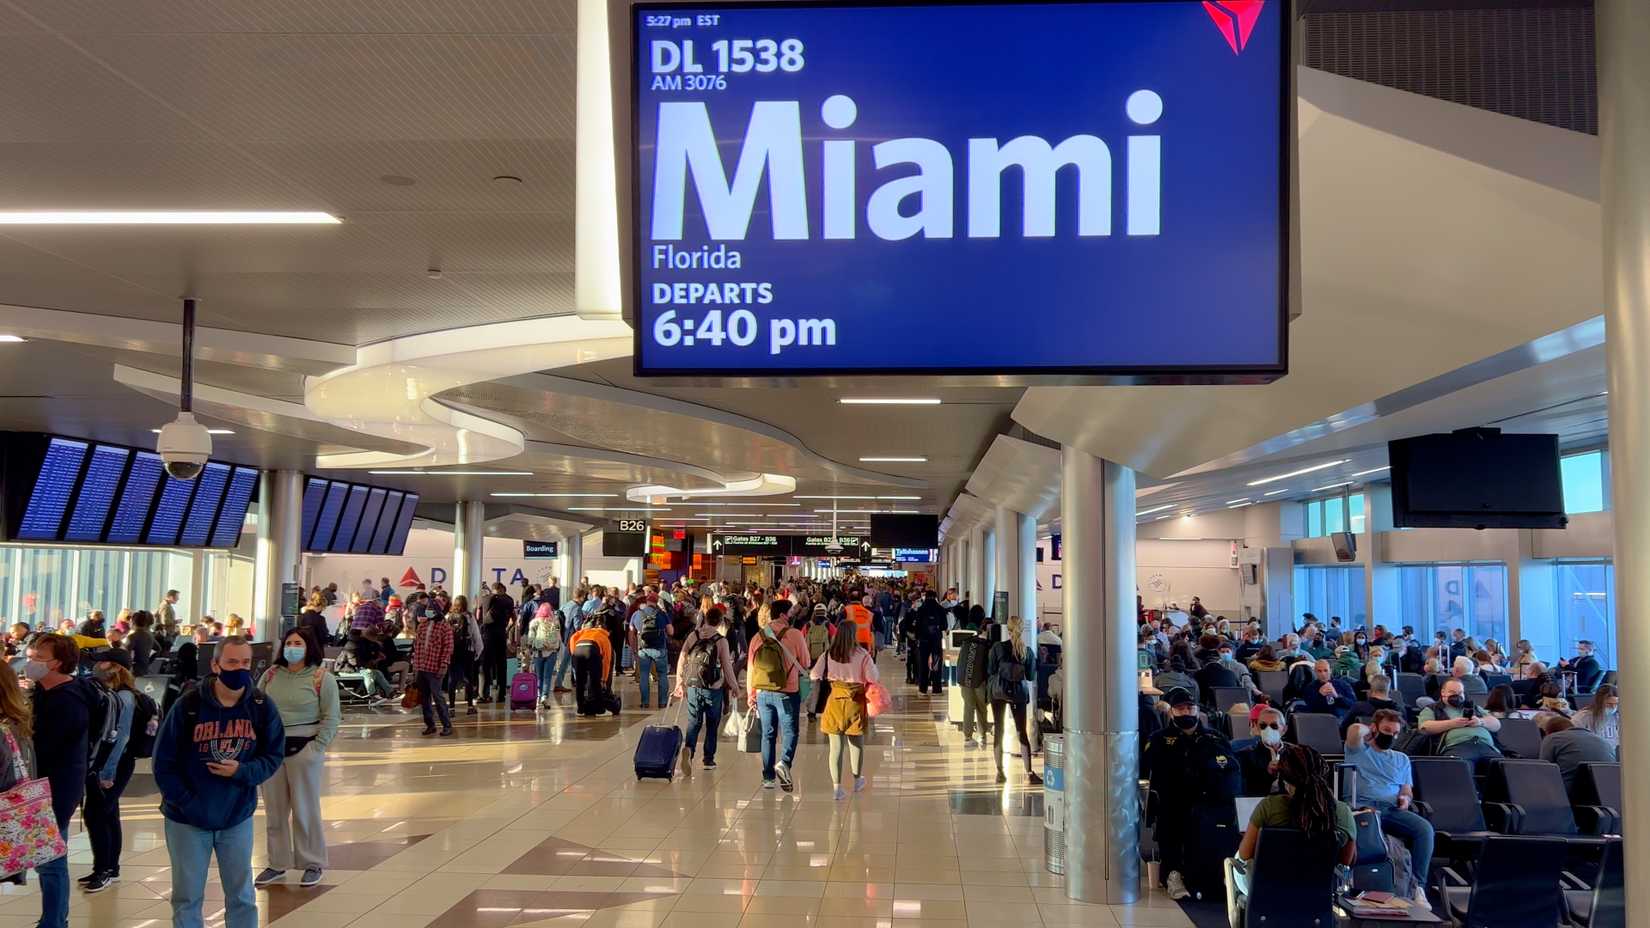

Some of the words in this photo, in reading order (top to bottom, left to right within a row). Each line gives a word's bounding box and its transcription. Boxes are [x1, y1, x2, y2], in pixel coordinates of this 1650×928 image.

[647, 16, 671, 27] 5:27
[672, 17, 691, 28] pm
[697, 15, 720, 26] EST
[651, 40, 703, 72] DL
[712, 39, 805, 72] 1538
[651, 76, 682, 90] AM
[685, 75, 727, 90] 3076
[651, 89, 1163, 241] Miami
[652, 244, 741, 269] Florida
[652, 283, 773, 304] DEPARTS
[653, 309, 758, 346] 6:40
[770, 318, 837, 354] pm
[620, 520, 645, 531] B26
[526, 545, 554, 553] Boarding
